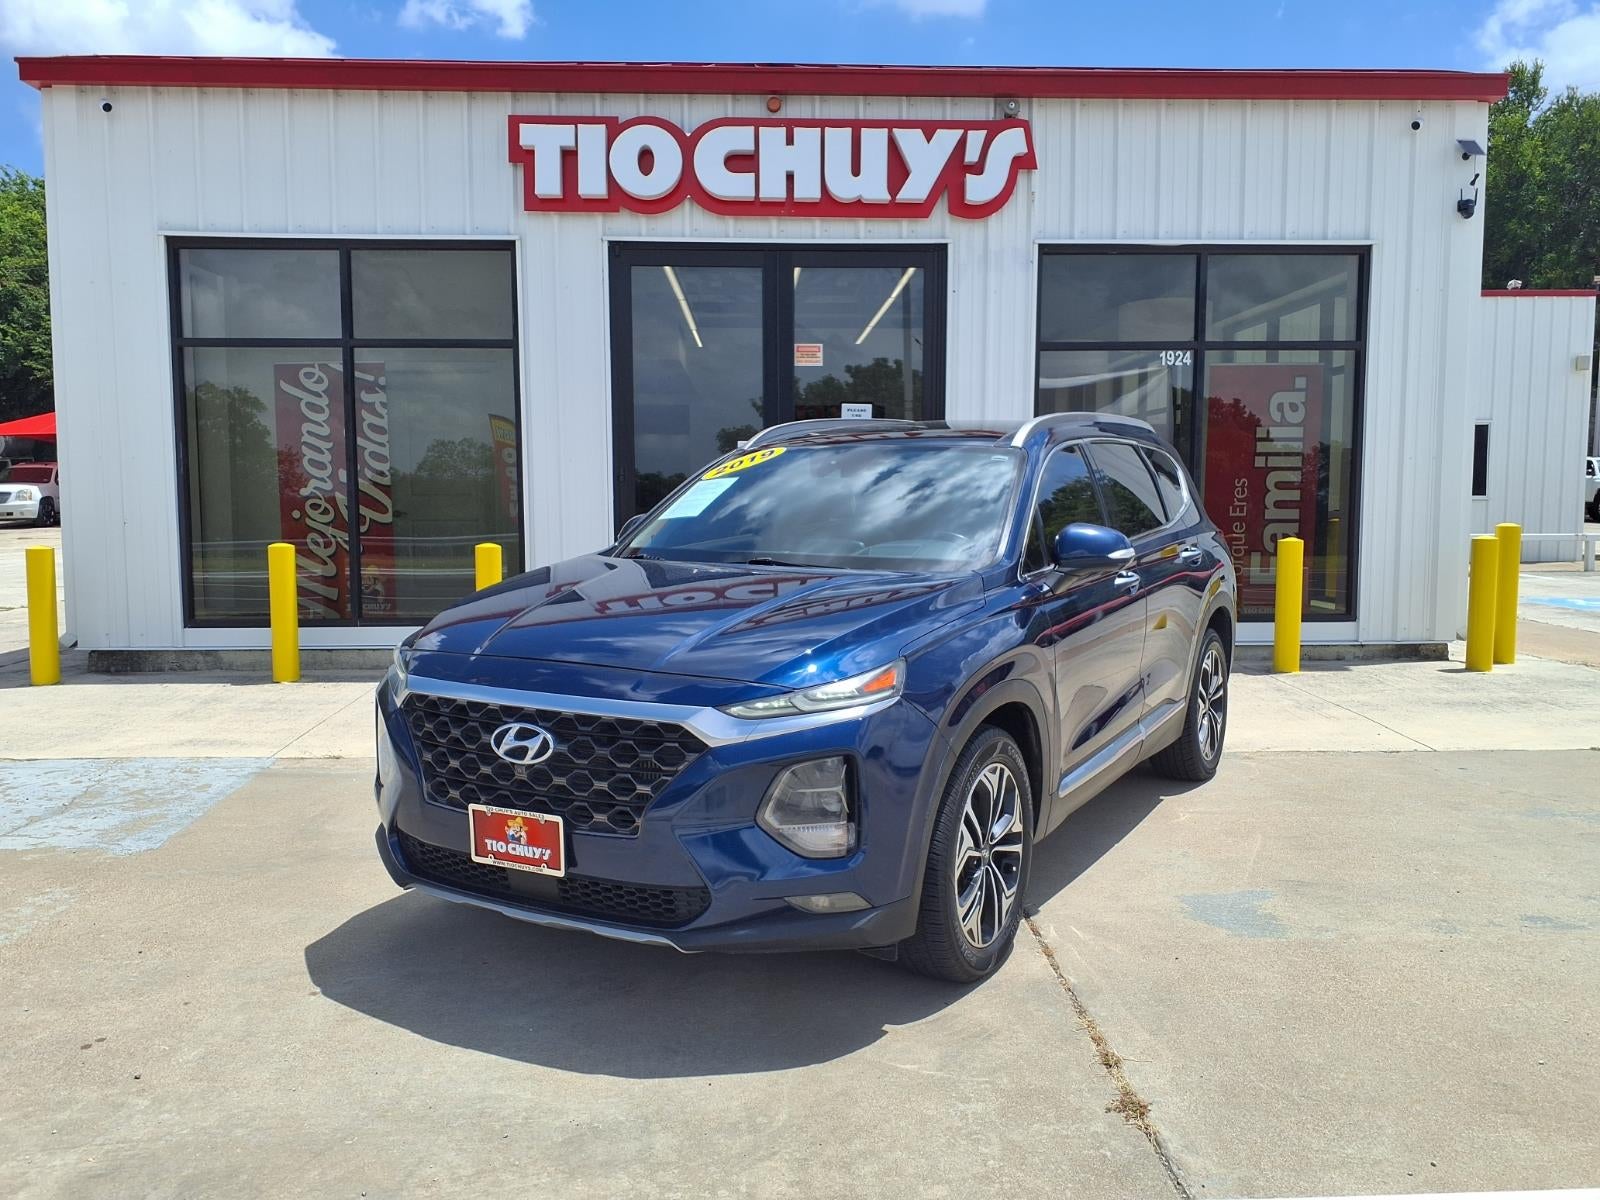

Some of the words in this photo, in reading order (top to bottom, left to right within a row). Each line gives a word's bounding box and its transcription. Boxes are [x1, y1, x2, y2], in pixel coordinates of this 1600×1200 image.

[1160, 351, 1191, 366] 1924
[711, 449, 775, 476] 2019
[1230, 478, 1248, 516] Eres
